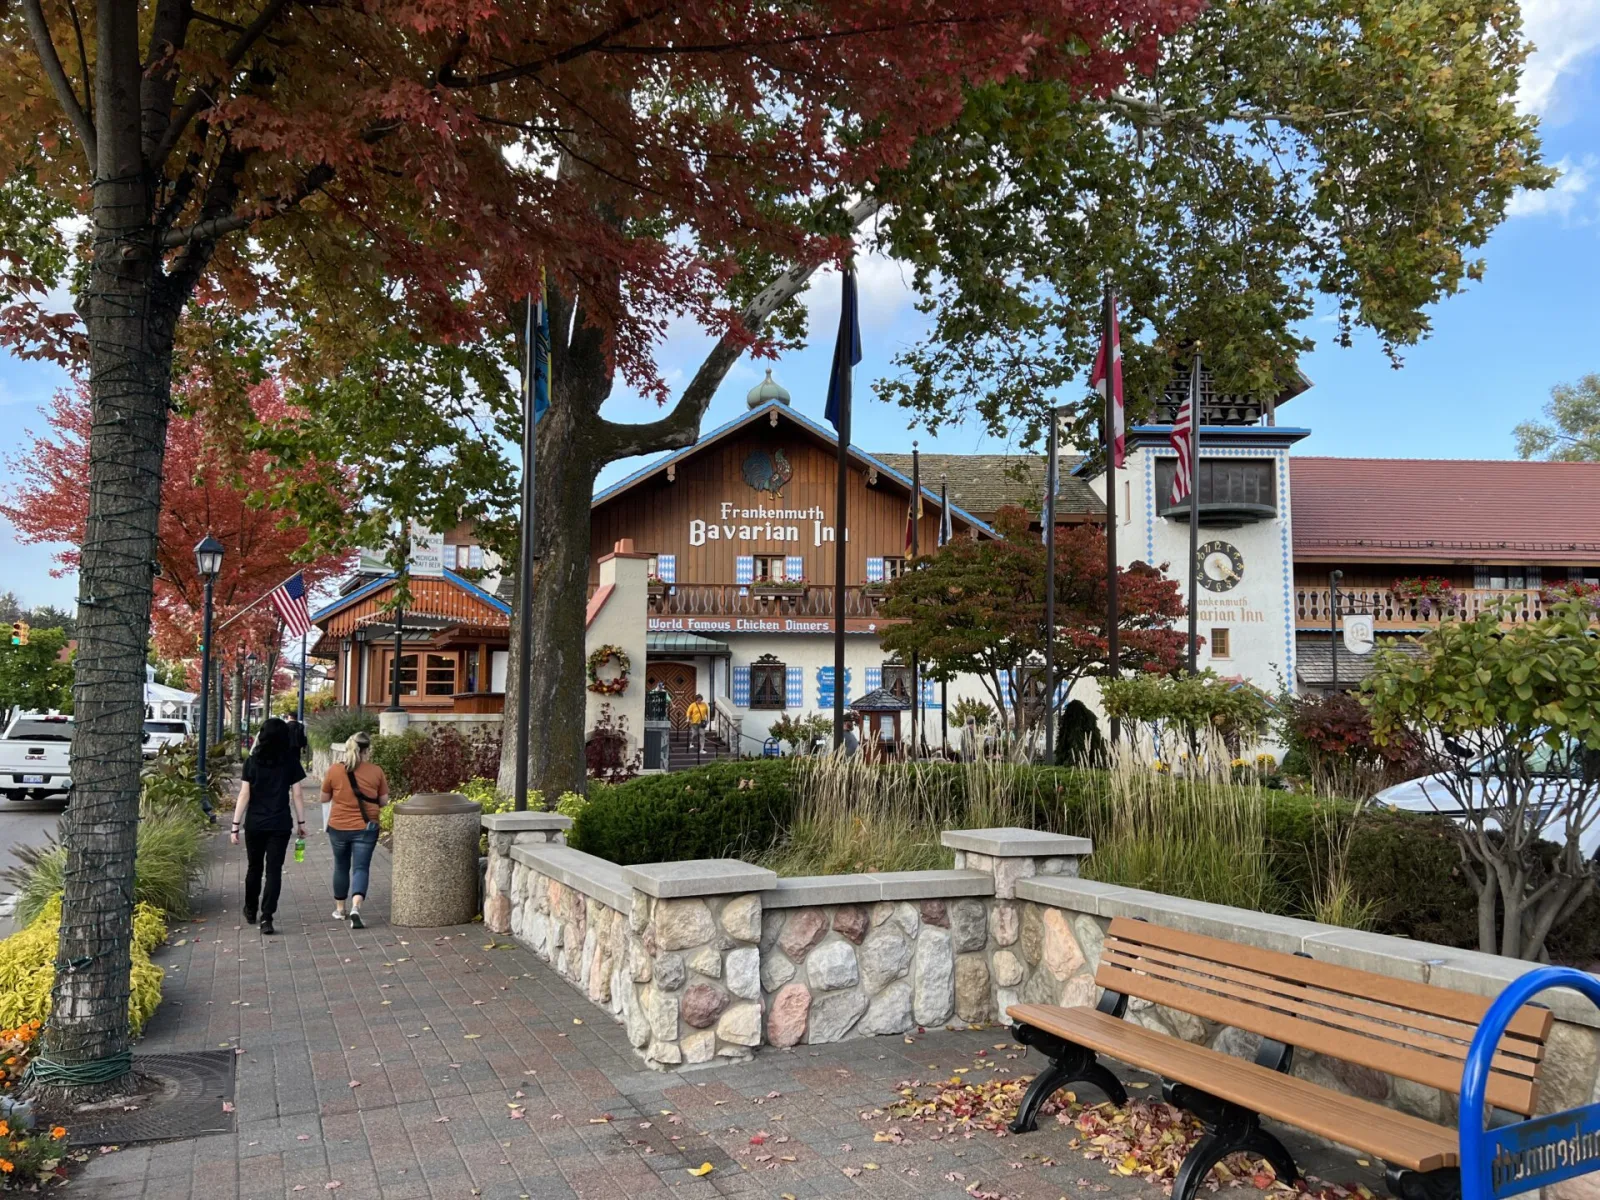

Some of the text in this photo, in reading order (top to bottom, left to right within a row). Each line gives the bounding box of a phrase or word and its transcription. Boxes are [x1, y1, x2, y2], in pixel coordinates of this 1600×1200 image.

[720, 502, 824, 520] Frankenmuth
[689, 519, 849, 547] Bavarian In
[1197, 597, 1247, 607] ankenmuth
[1240, 607, 1264, 622] Inn
[649, 619, 829, 631] World Famous Chicken Dinners
